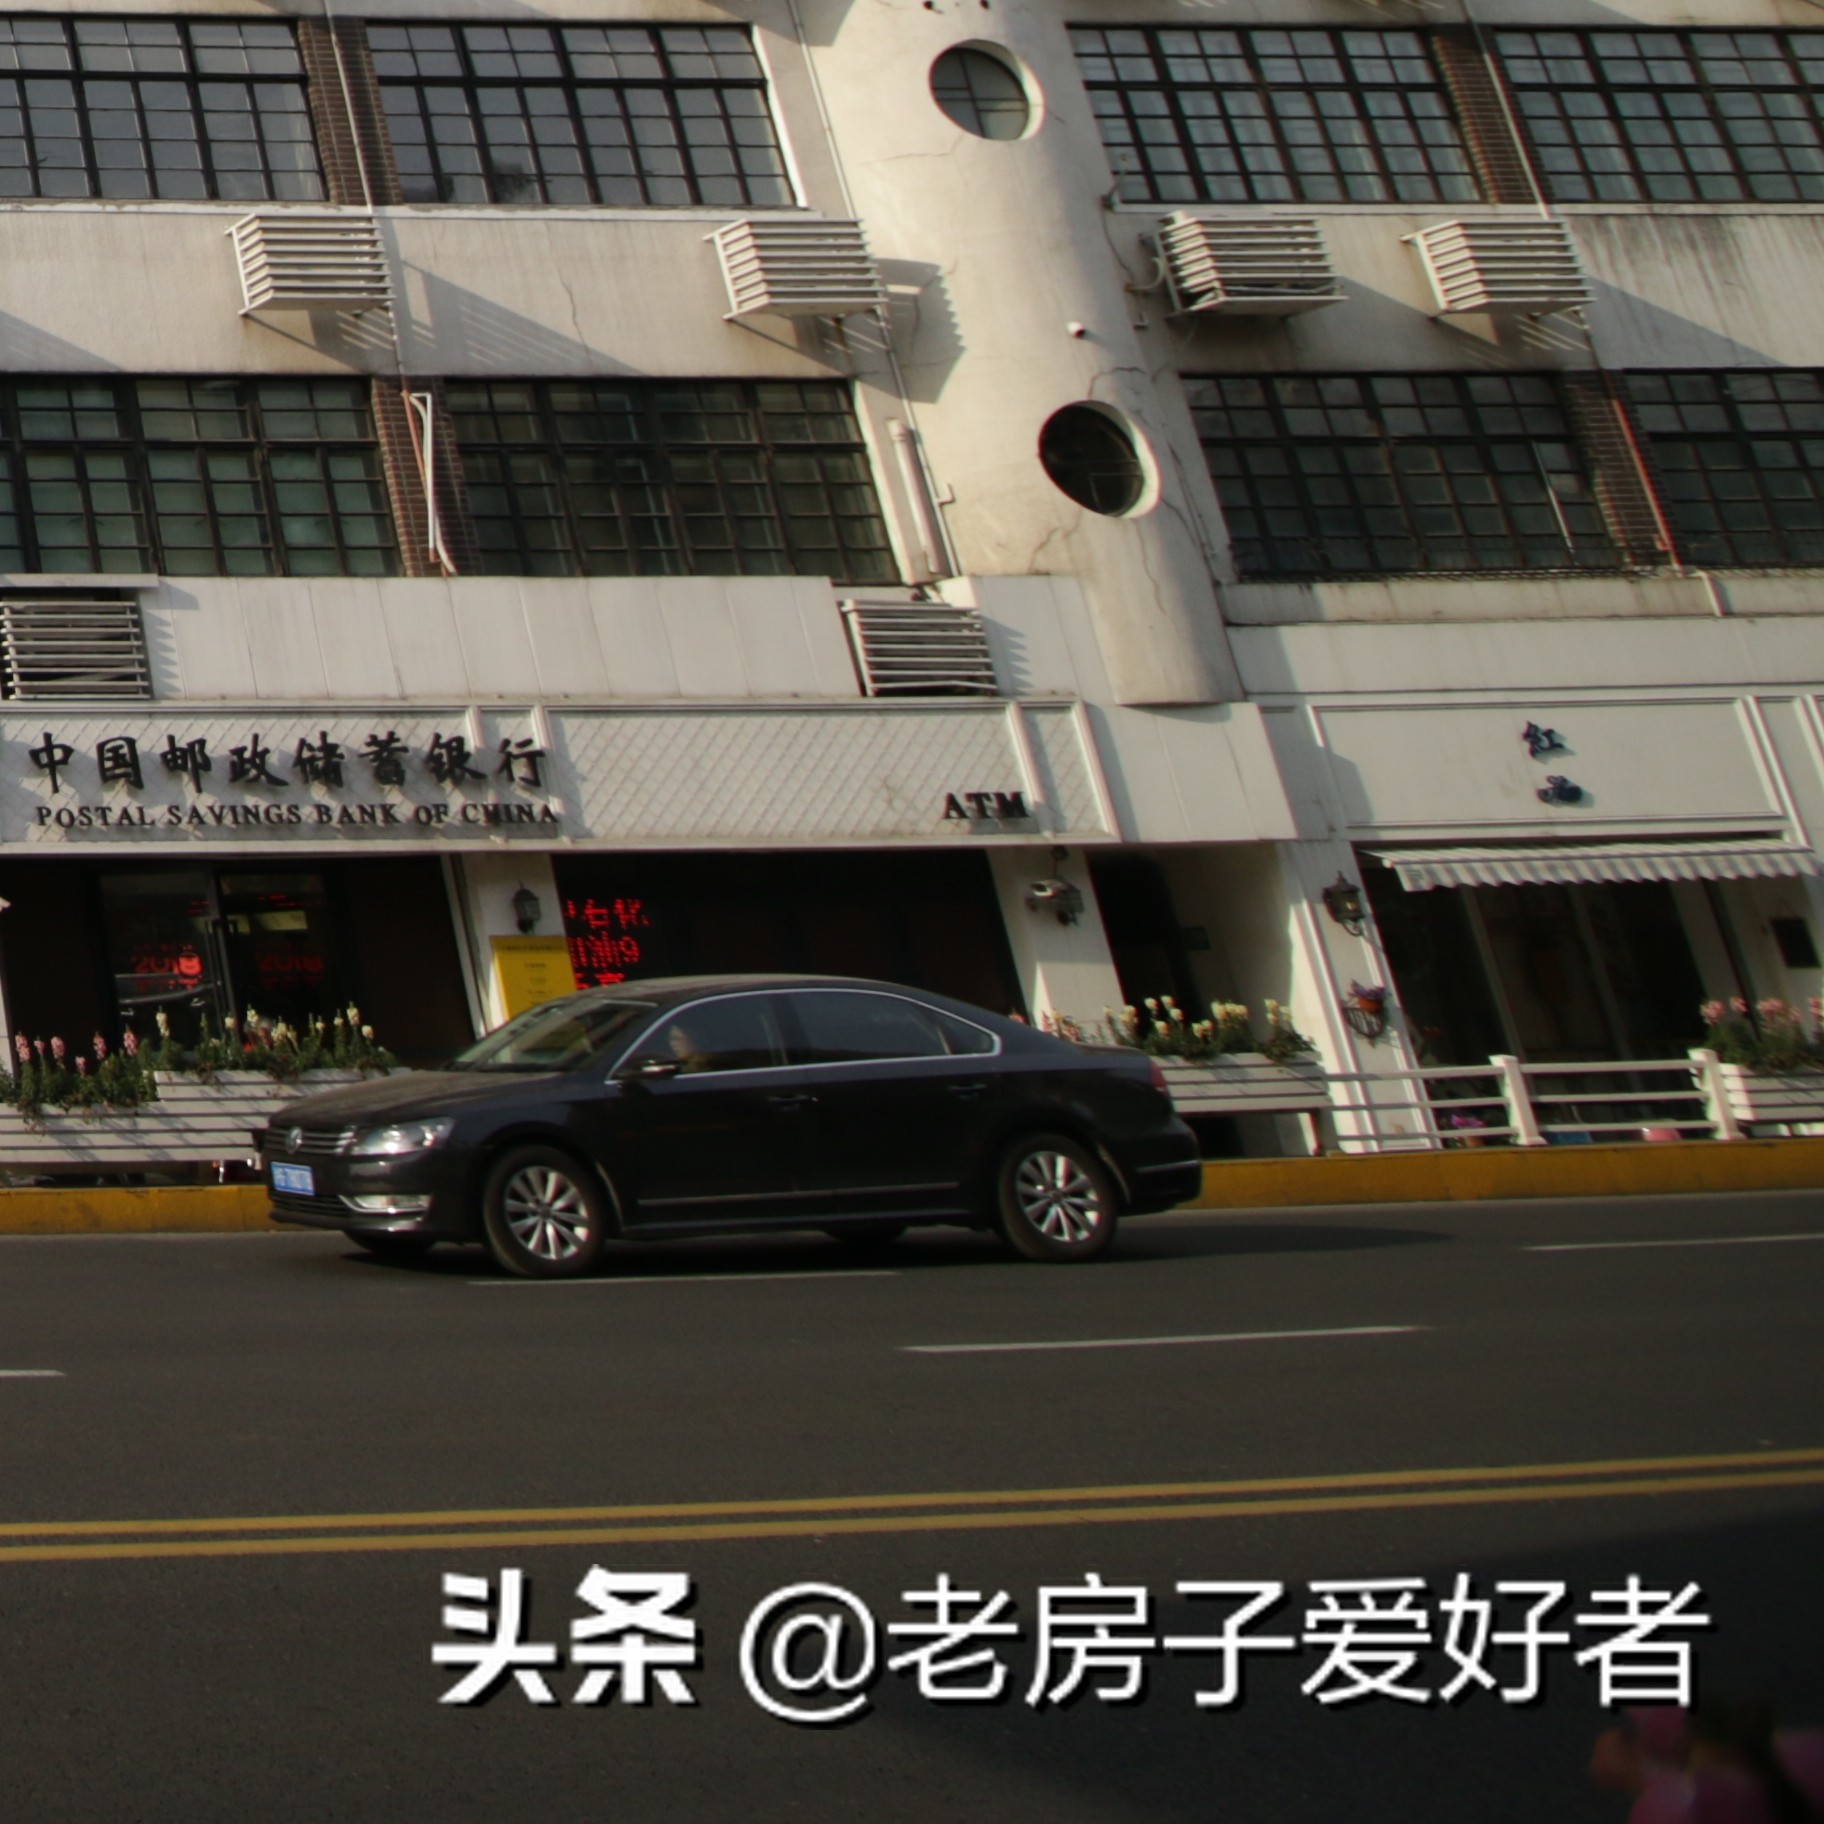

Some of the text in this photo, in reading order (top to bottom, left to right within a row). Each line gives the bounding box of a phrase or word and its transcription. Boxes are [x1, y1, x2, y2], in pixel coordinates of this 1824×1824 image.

[28, 730, 547, 794] 中国邮政储蓄银行
[36, 802, 560, 828] POSTAL SAVINGS BANK OF CHINA
[943, 790, 1031, 821] ATM
